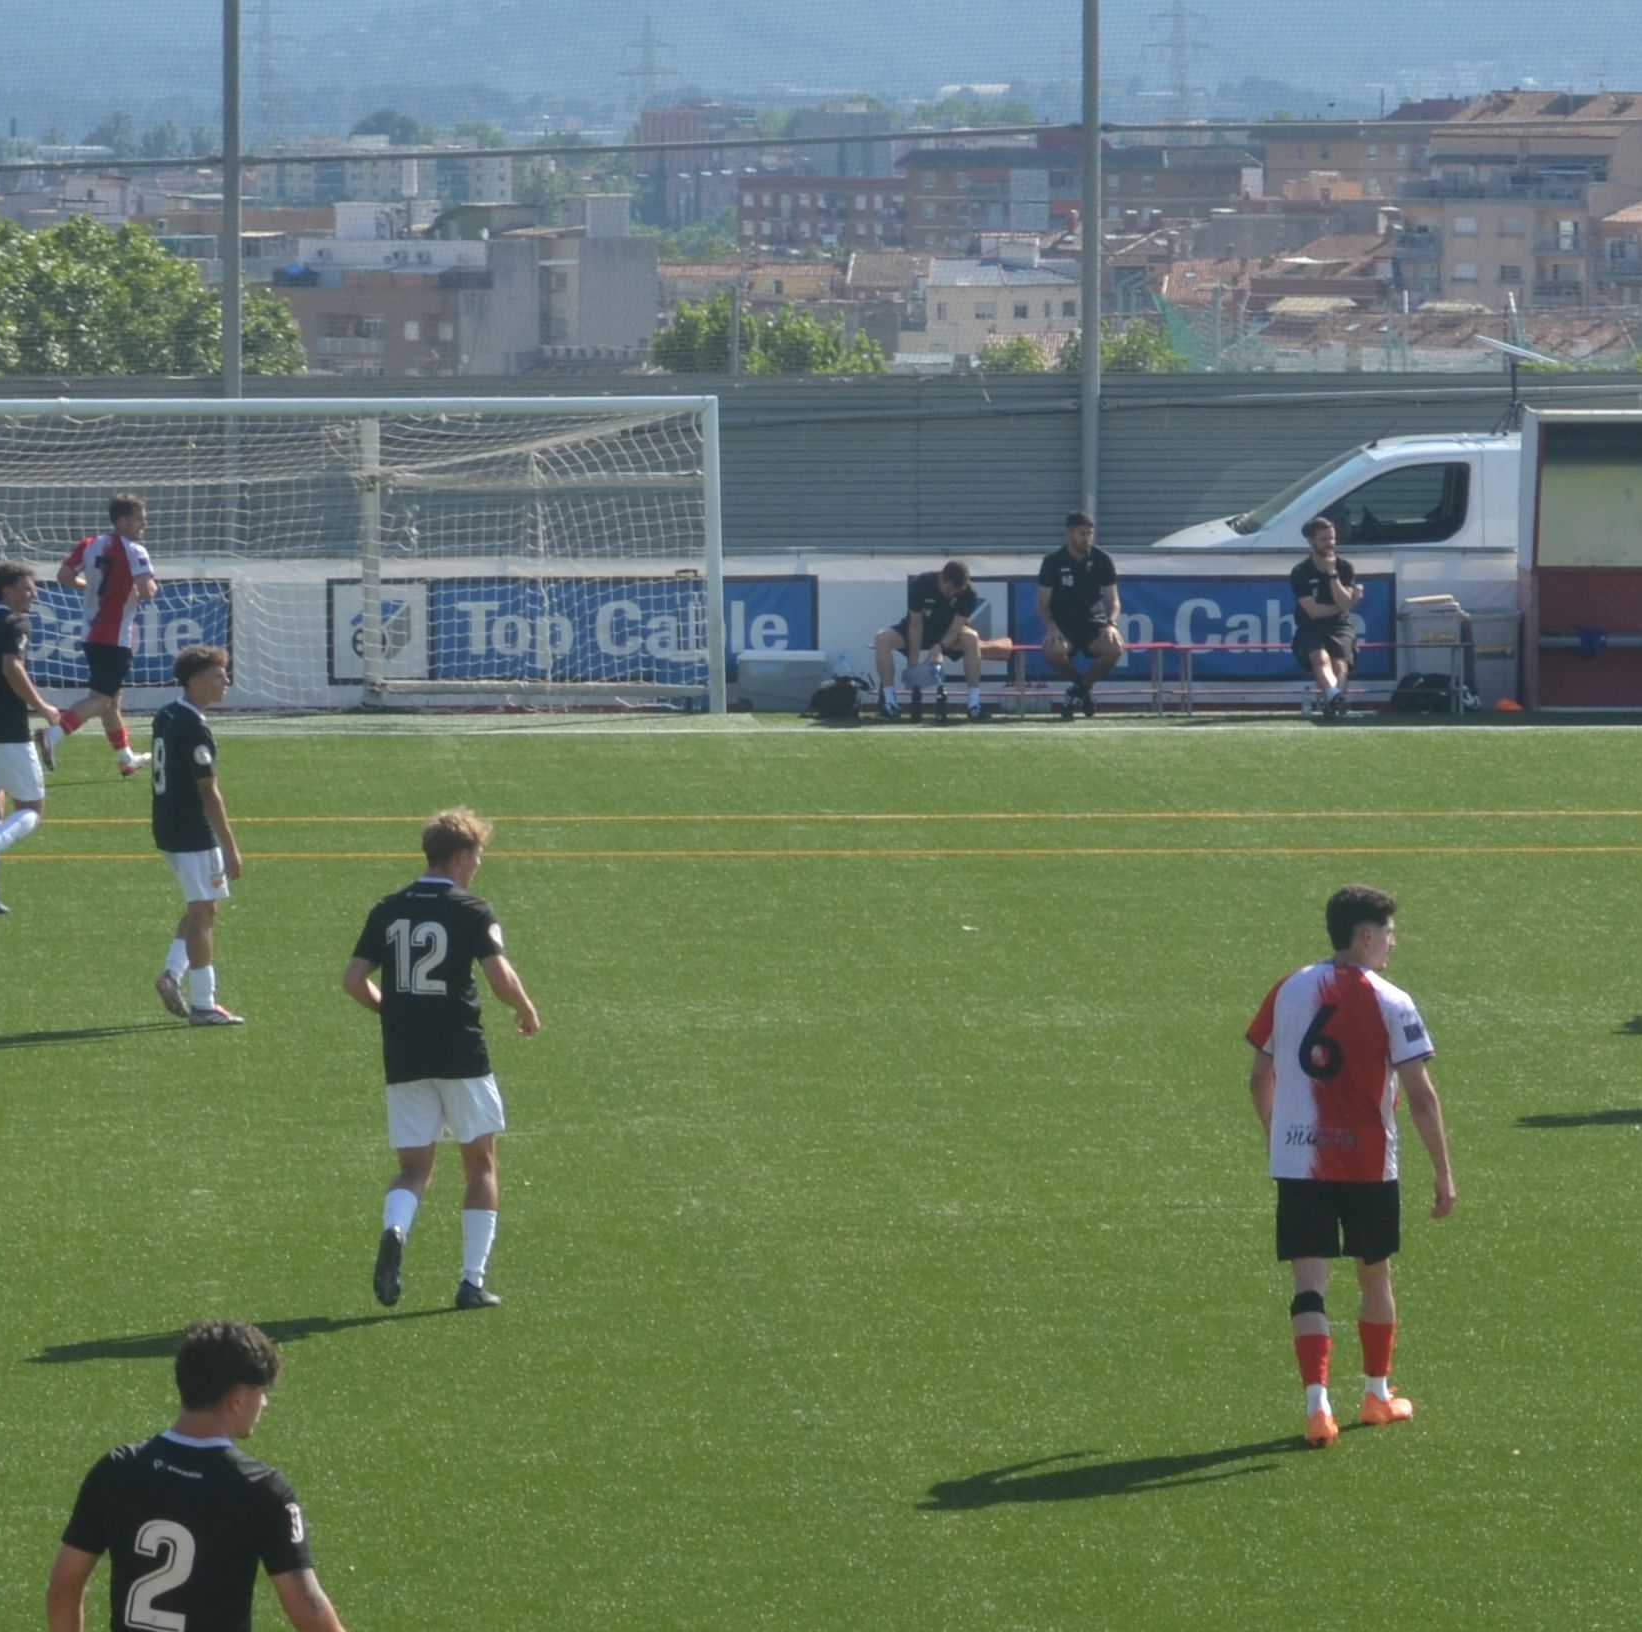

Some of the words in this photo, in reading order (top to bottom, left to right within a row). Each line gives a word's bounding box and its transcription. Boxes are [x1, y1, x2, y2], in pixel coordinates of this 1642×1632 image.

[457, 600, 574, 669] Top
[385, 918, 448, 996] 12
[1298, 1003, 1344, 1081] 6
